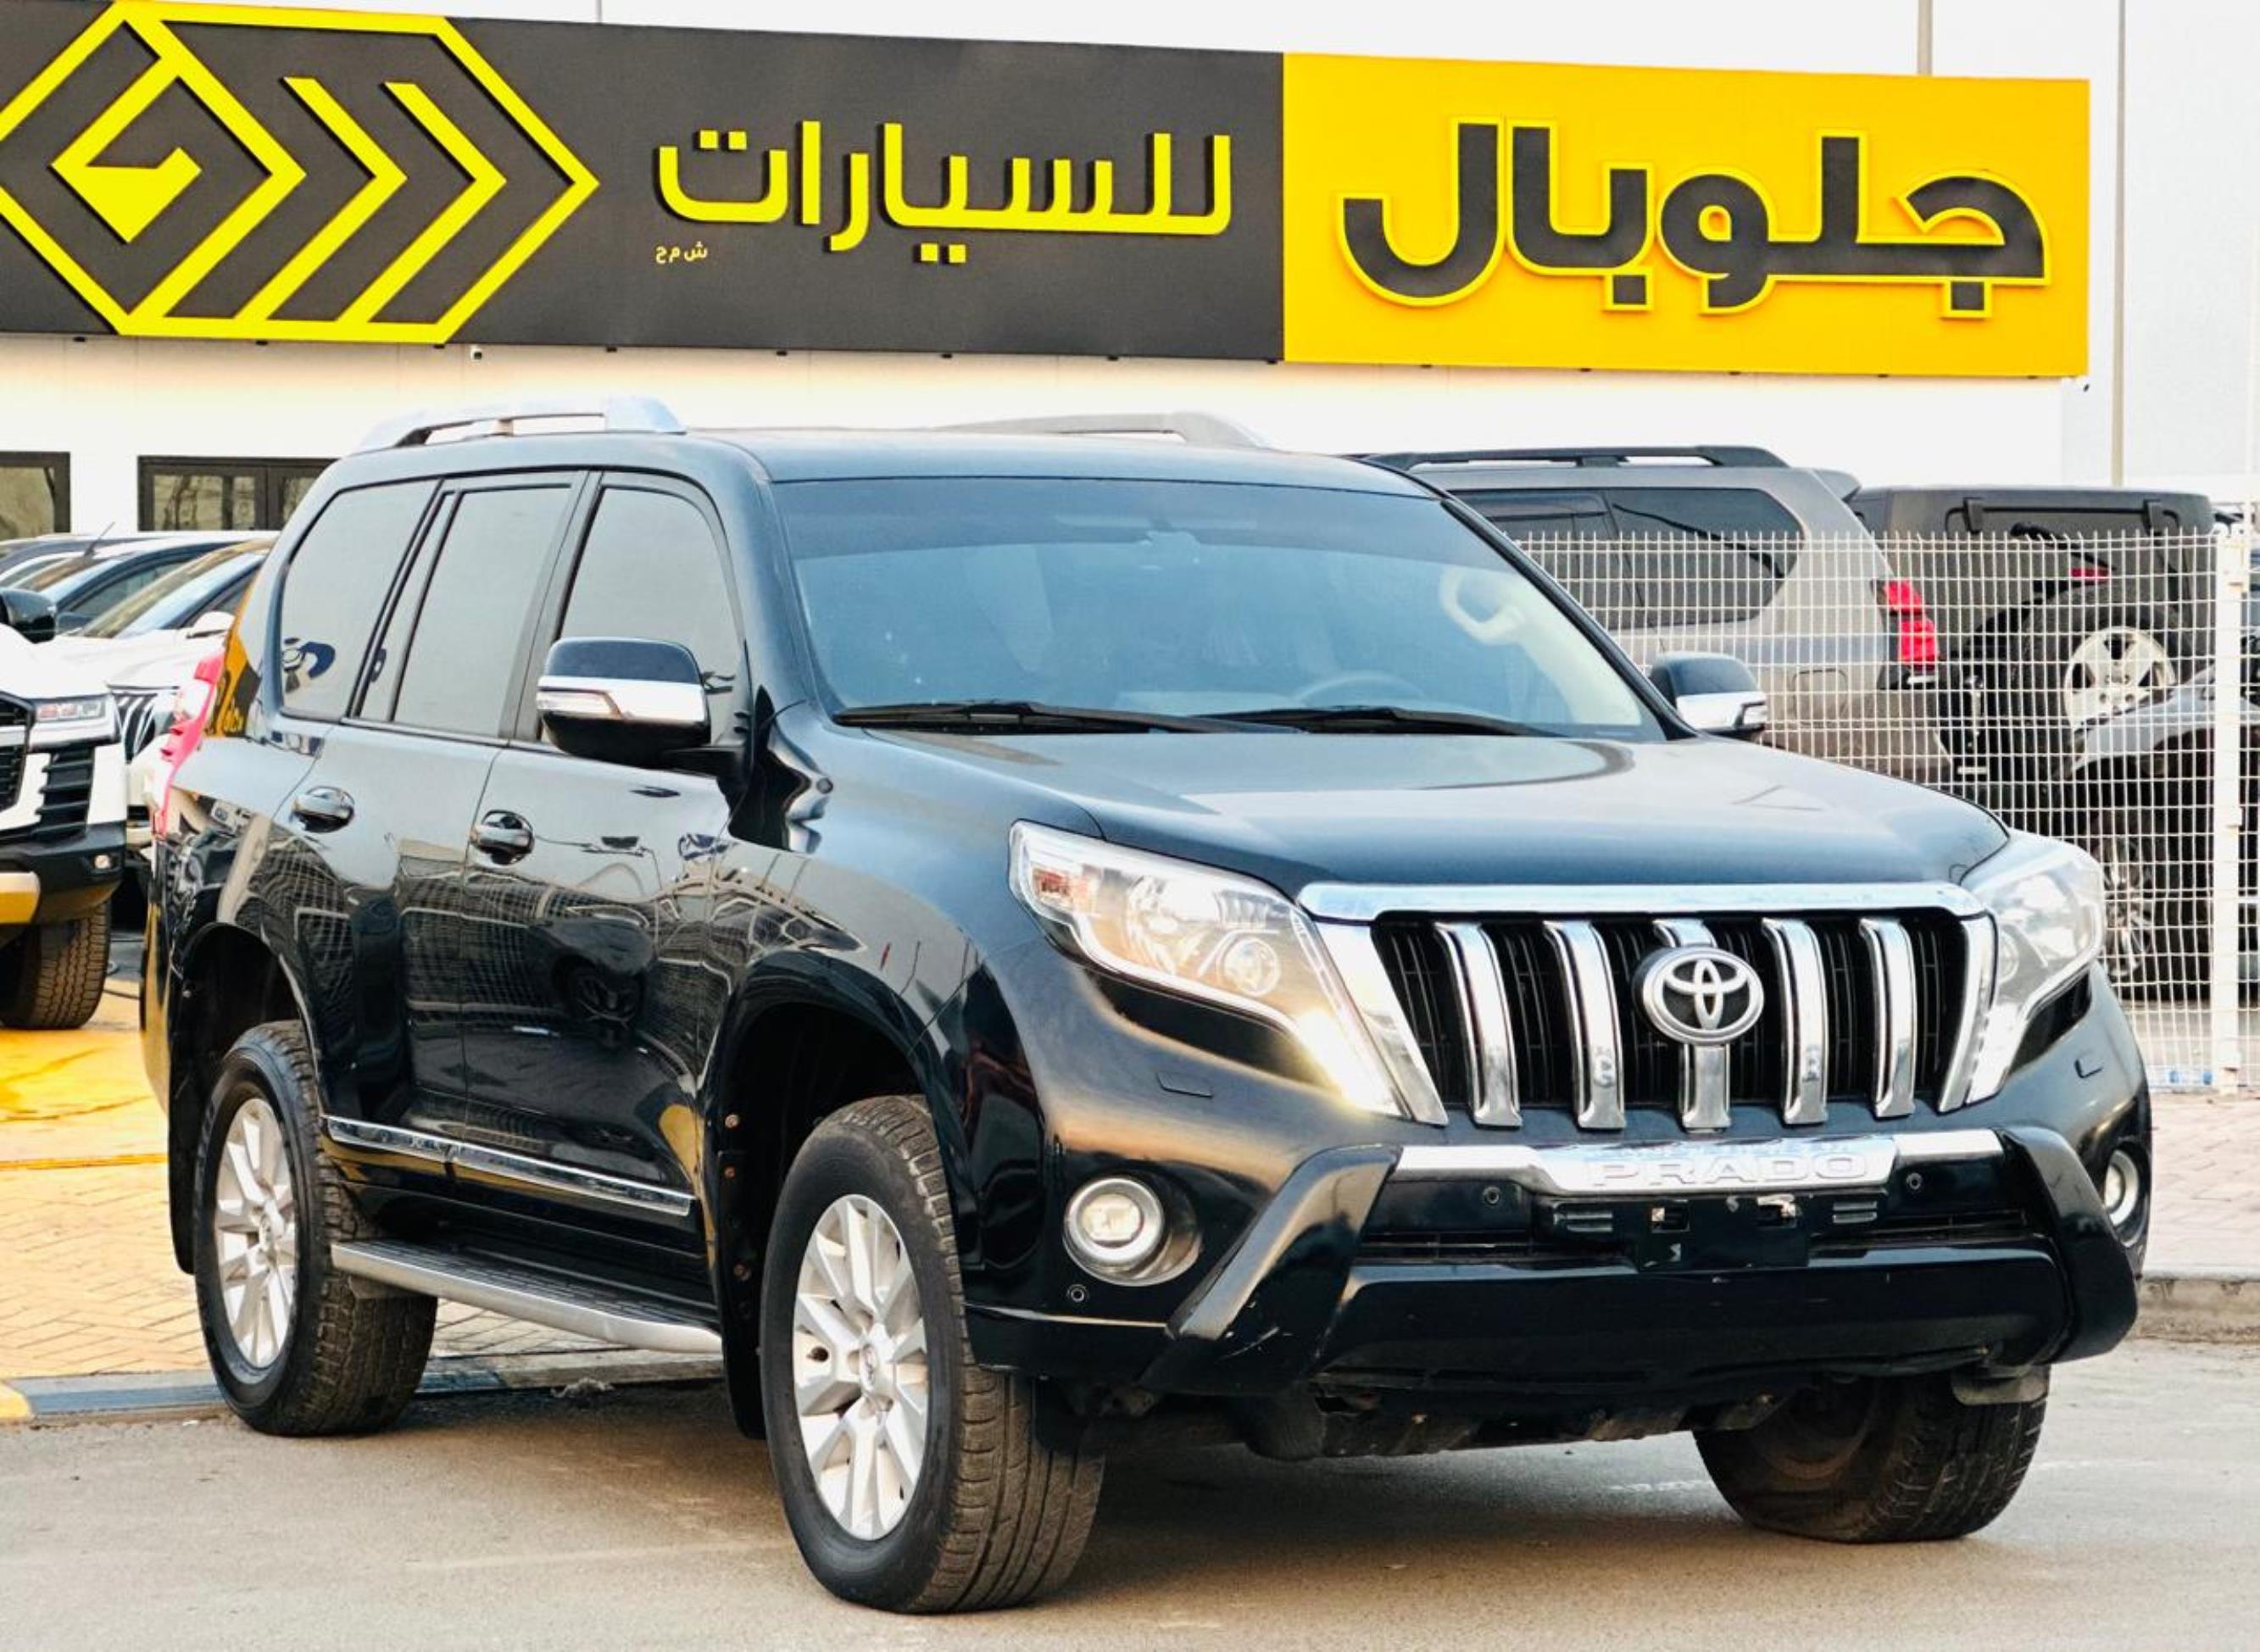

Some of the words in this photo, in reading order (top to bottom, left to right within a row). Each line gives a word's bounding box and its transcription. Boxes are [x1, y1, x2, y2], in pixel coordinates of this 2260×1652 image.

[657, 120, 1232, 264] للسيارات
[1337, 116, 2051, 318] جلوبال
[1591, 1153, 1868, 1188] PRADO
